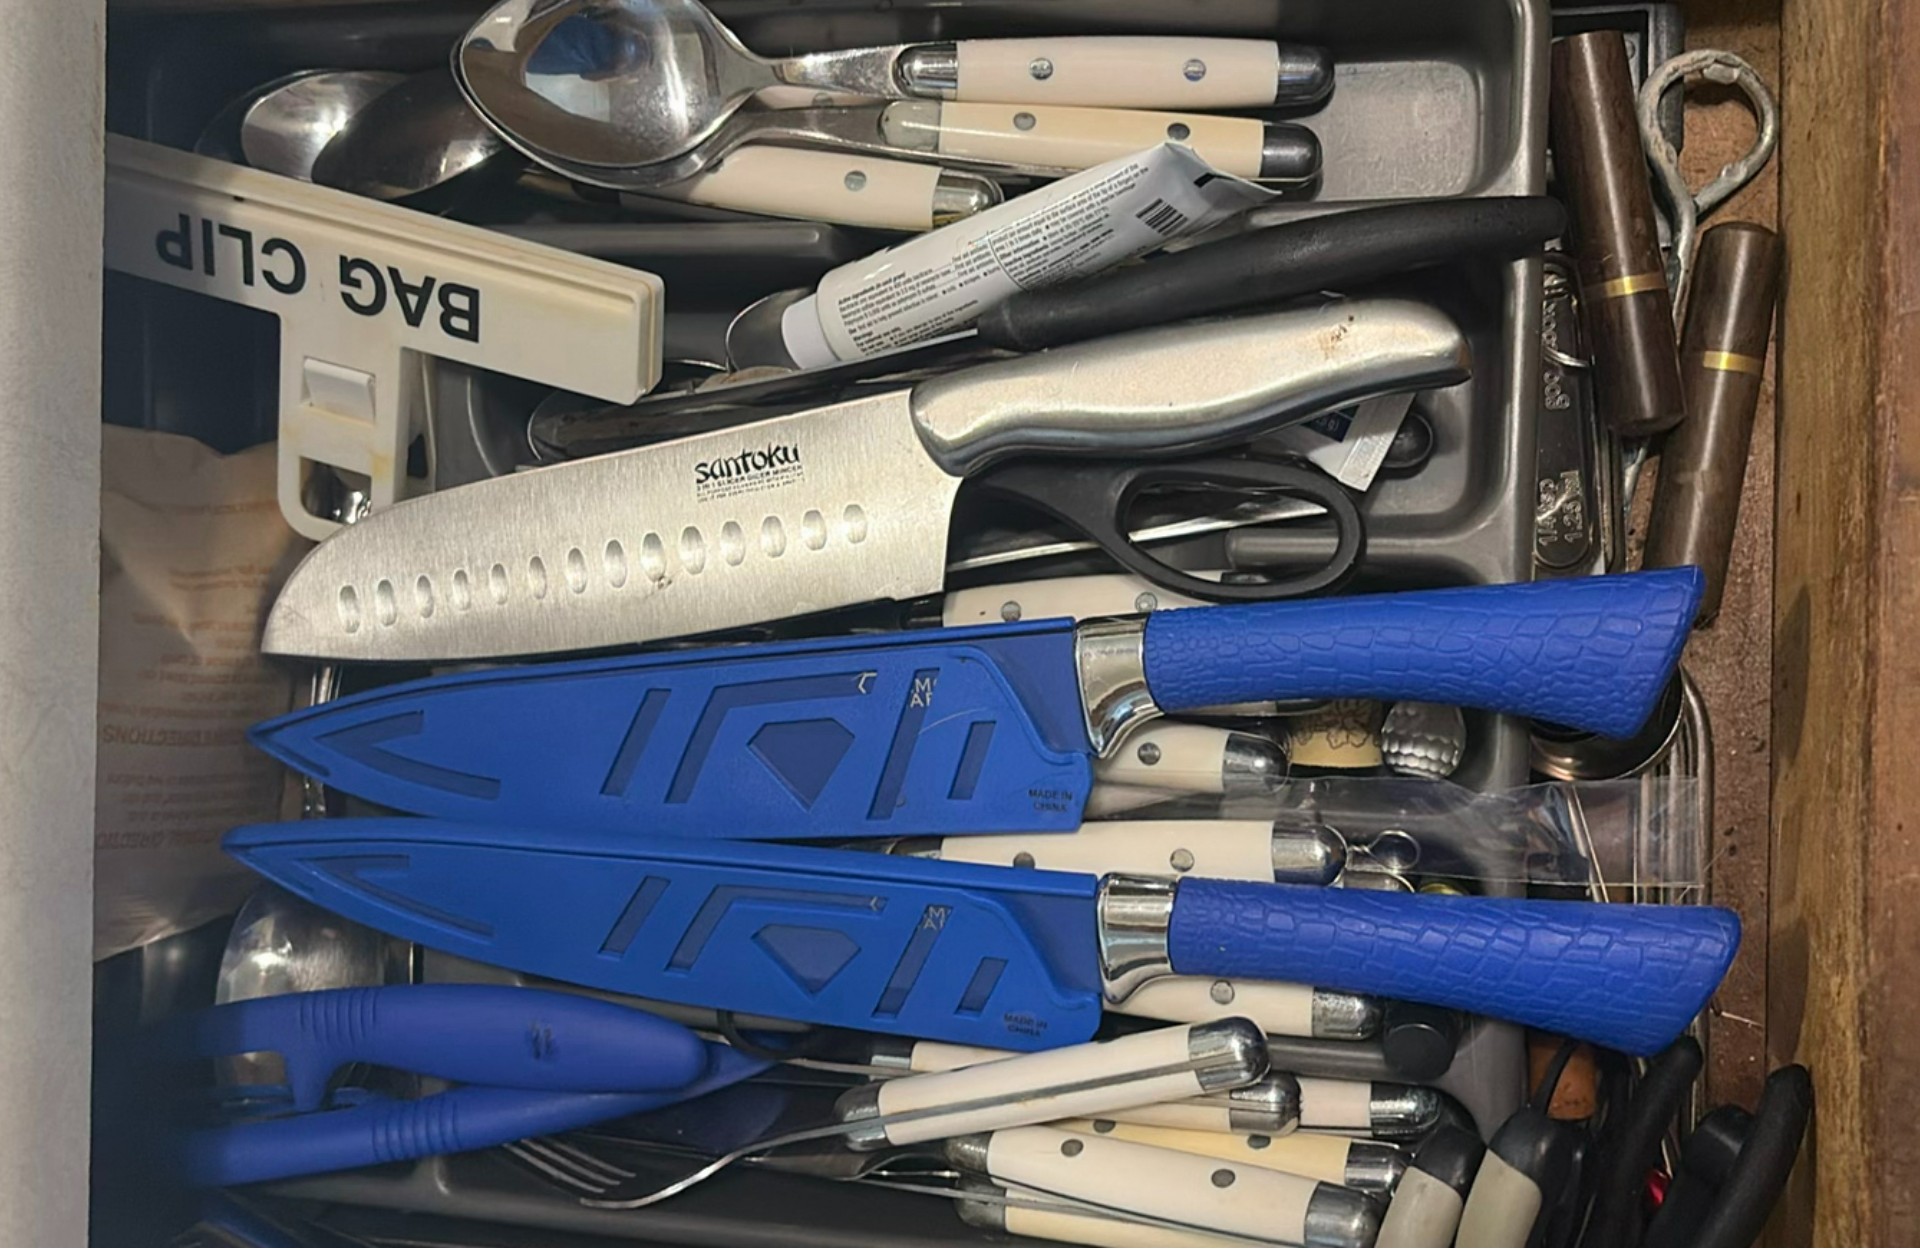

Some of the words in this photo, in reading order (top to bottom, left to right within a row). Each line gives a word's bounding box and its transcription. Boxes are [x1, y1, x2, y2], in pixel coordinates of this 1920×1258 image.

[155, 212, 308, 296] CLIP
[338, 253, 480, 346] BAG
[694, 441, 800, 485] santoku
[1028, 788, 1057, 800] MADE
[1061, 791, 1073, 801] IN
